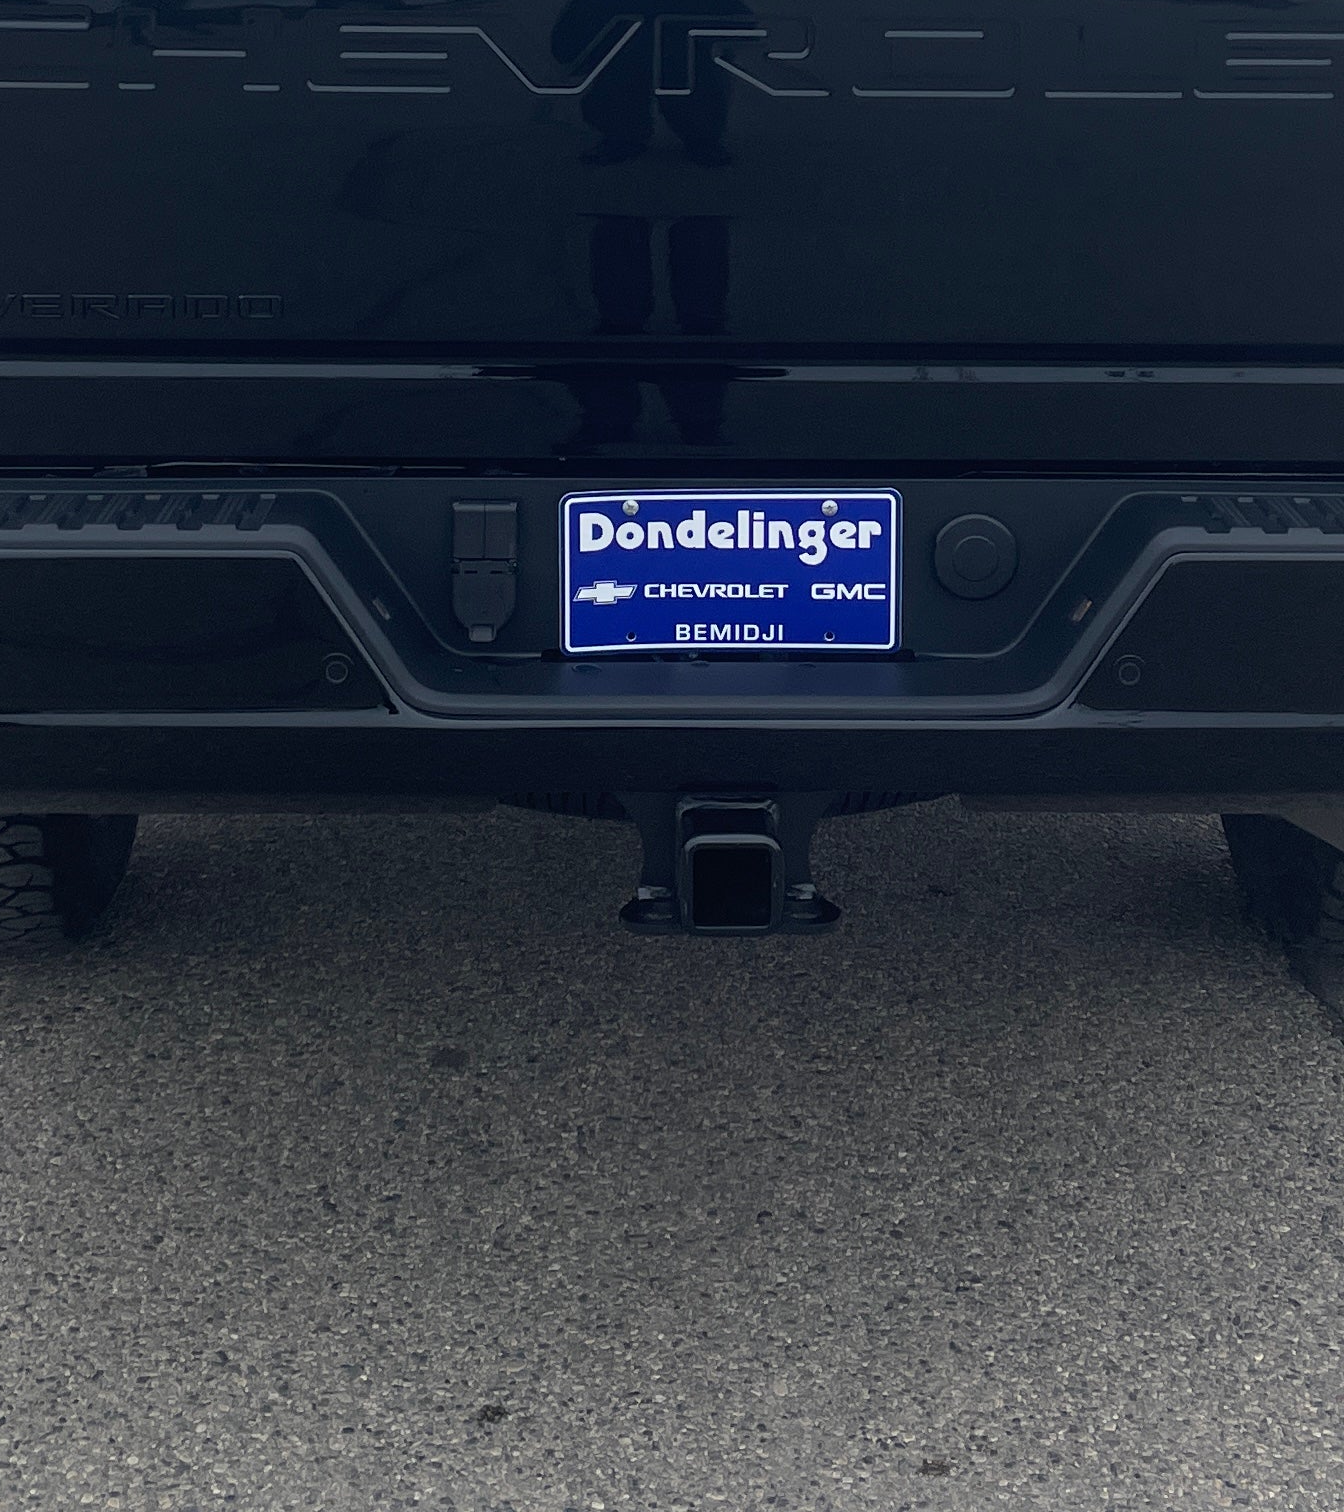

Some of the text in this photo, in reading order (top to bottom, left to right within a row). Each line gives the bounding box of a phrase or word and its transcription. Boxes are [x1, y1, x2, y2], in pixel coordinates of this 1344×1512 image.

[579, 510, 882, 566] Dondelinger
[644, 583, 886, 600] CHEVROLET GMC
[675, 624, 784, 641] BEMIDJI
